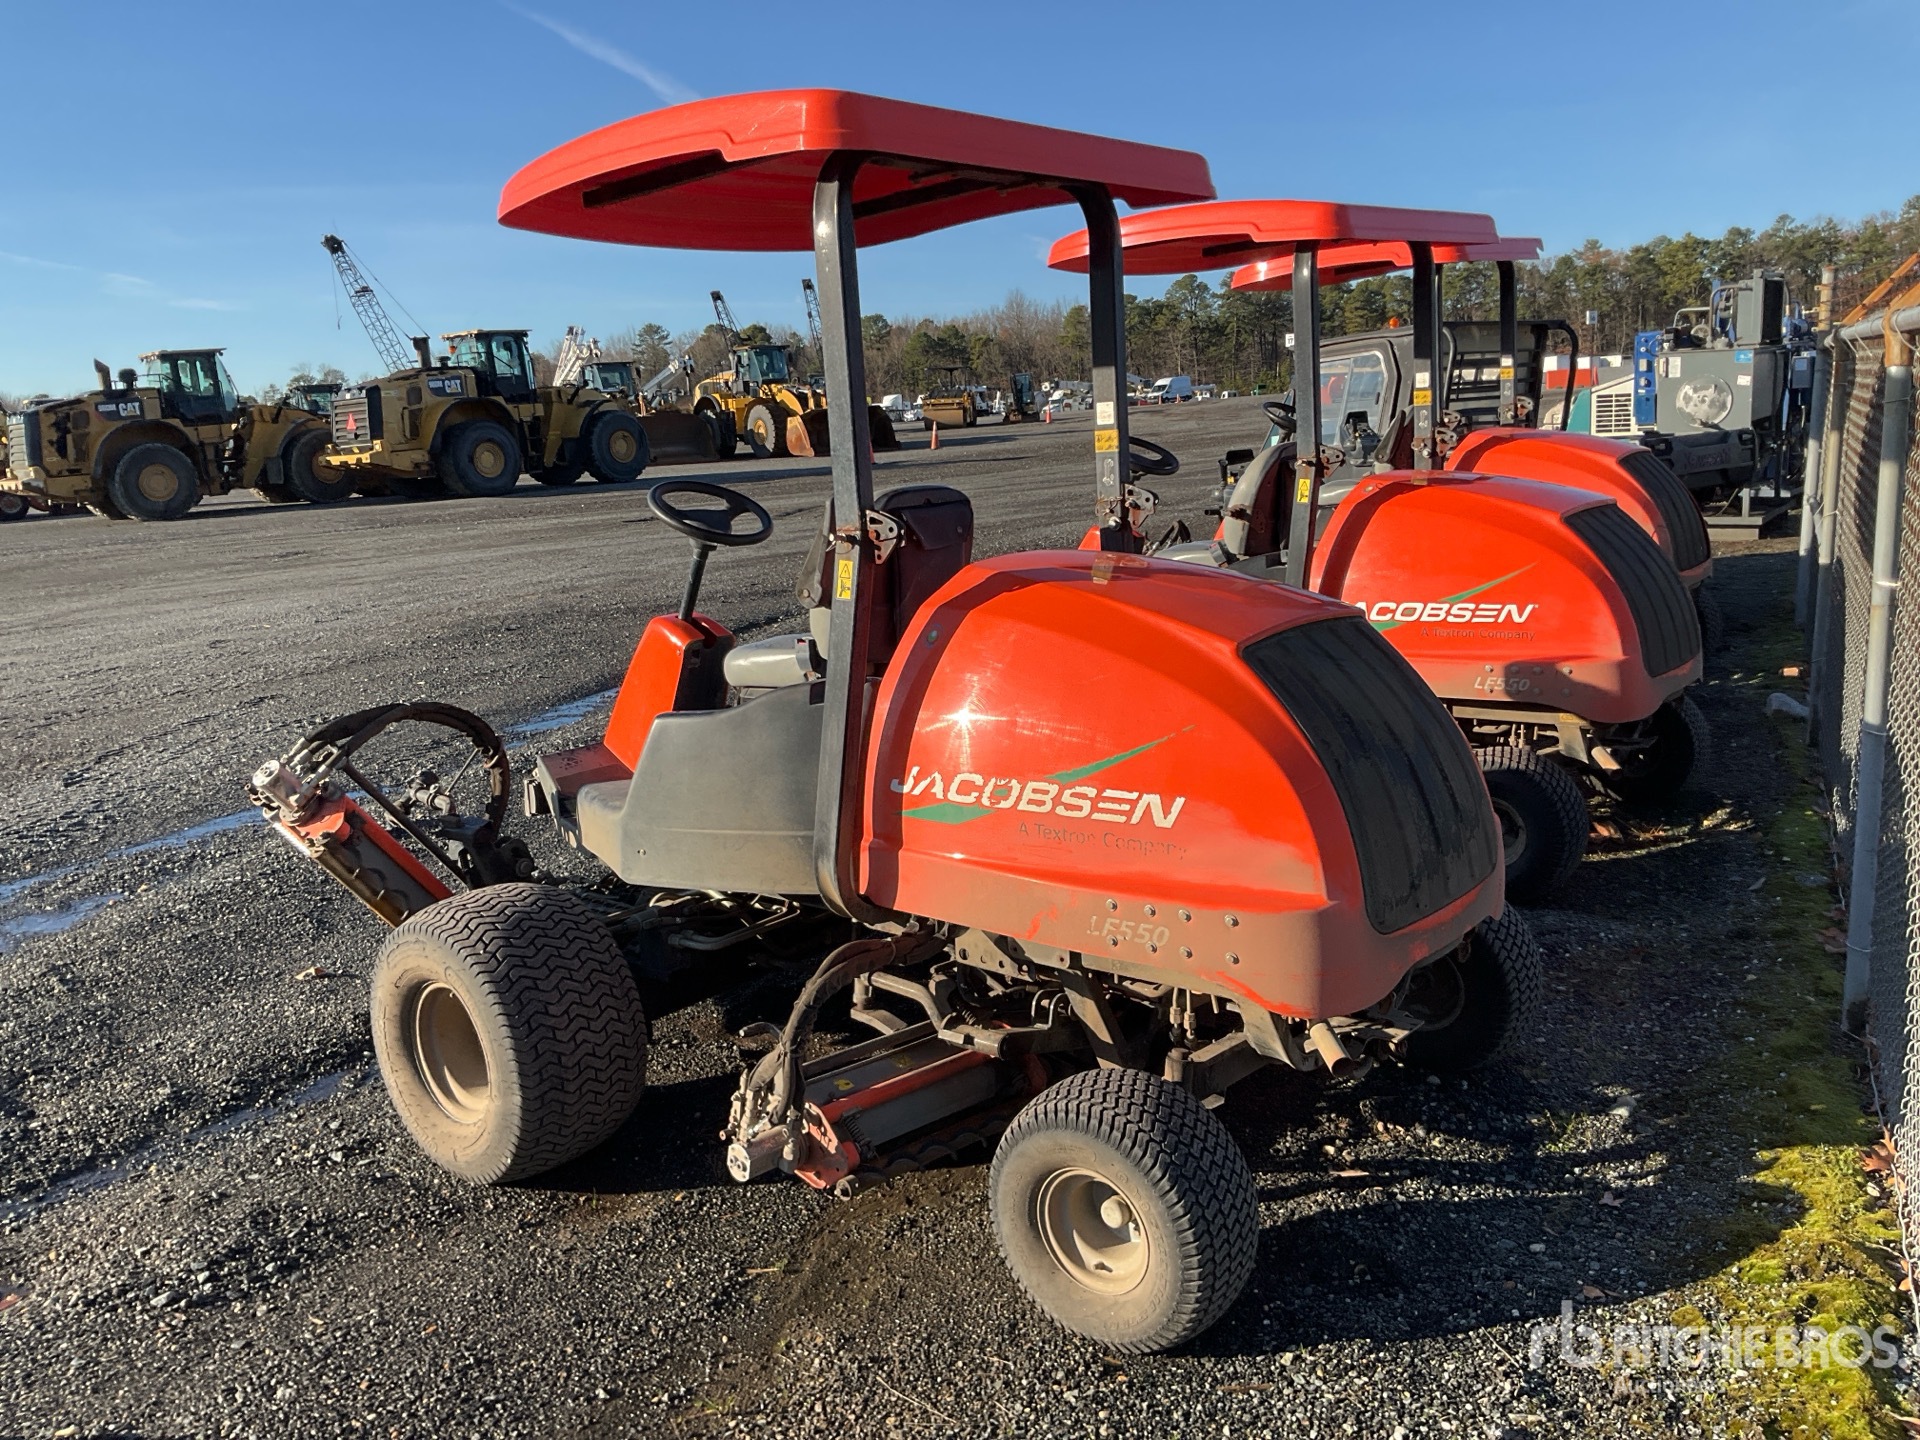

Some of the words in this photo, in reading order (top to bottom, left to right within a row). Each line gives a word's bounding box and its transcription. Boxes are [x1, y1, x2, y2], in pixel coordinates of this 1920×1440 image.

[444, 379, 462, 393] CAT
[118, 401, 141, 417] CAT
[1354, 600, 1535, 624] COBSEN
[1421, 627, 1430, 638] A
[1433, 628, 1476, 639] Textron
[1479, 629, 1536, 641] Company
[1474, 675, 1530, 691] LF550
[890, 765, 1186, 830] JACOBSEN
[1019, 821, 1030, 837] A
[1034, 823, 1096, 846] Textron
